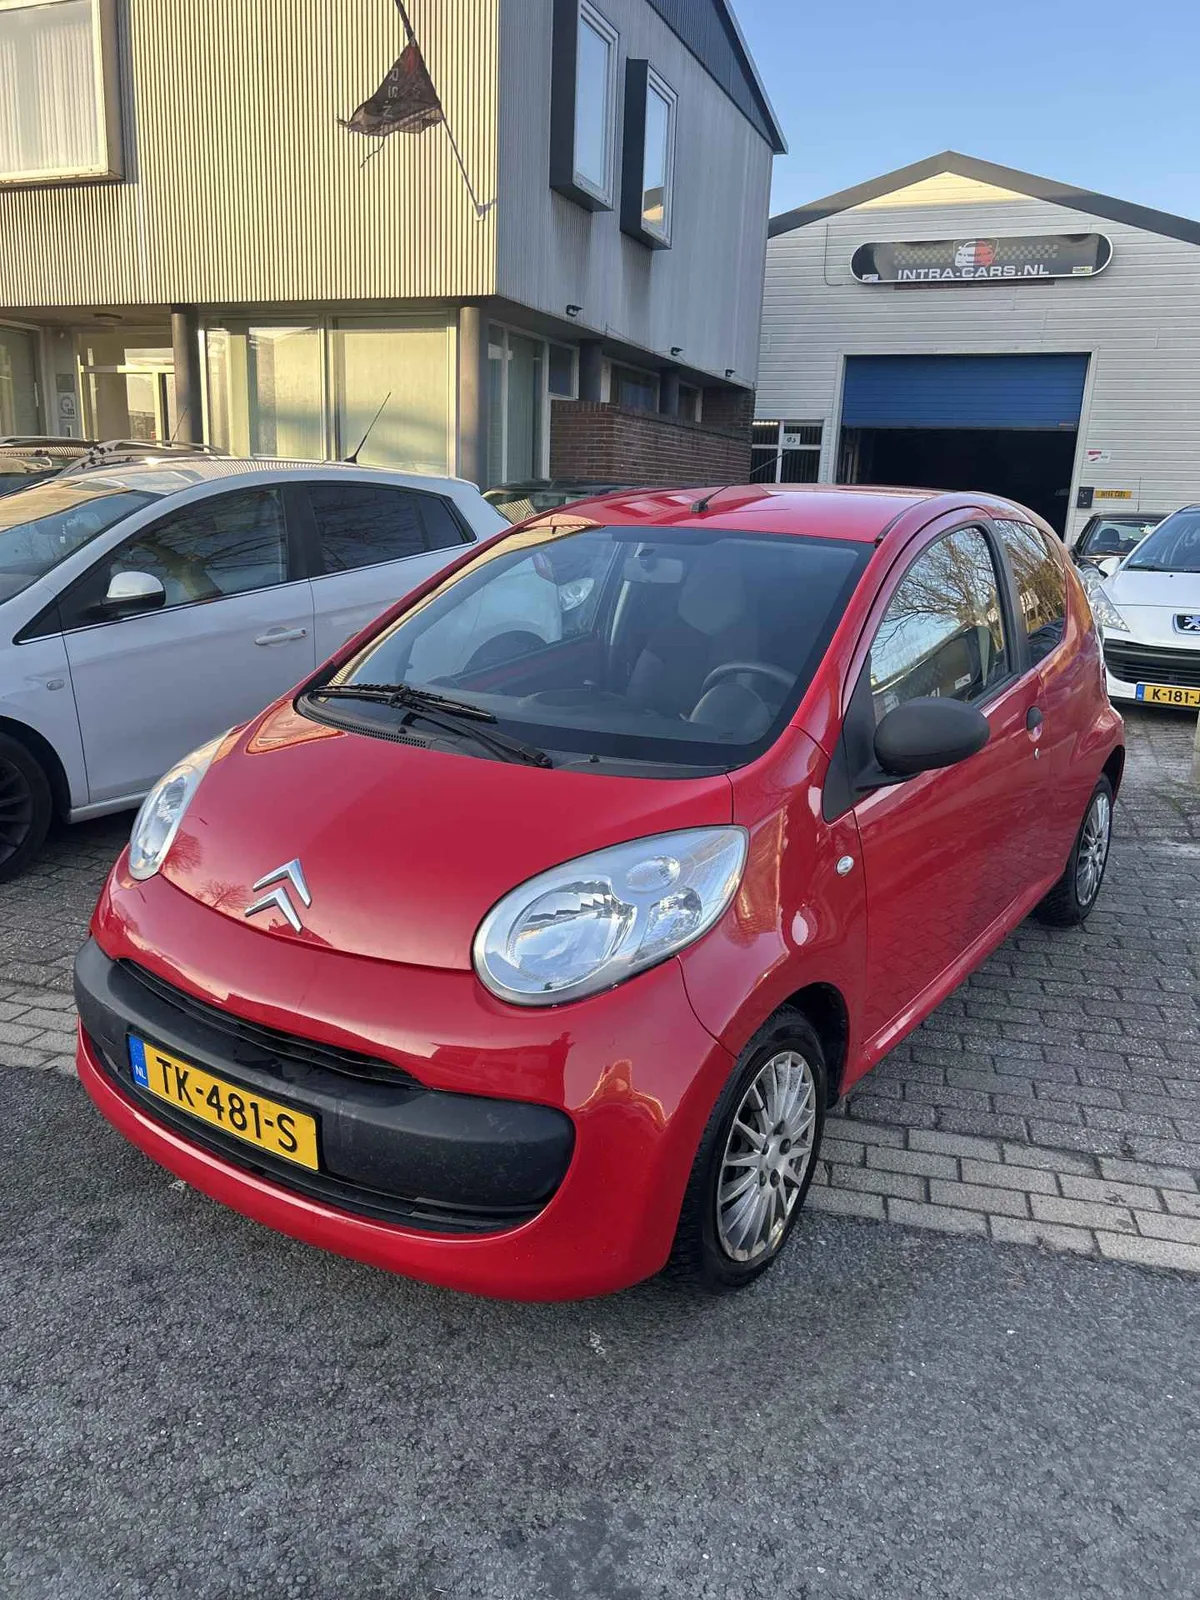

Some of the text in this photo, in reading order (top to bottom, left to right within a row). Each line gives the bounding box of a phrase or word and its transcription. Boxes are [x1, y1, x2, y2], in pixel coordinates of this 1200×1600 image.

[897, 264, 1050, 280] INTRA-CARS.NL
[135, 1064, 147, 1080] NL
[156, 1056, 298, 1153] TK-481-S
